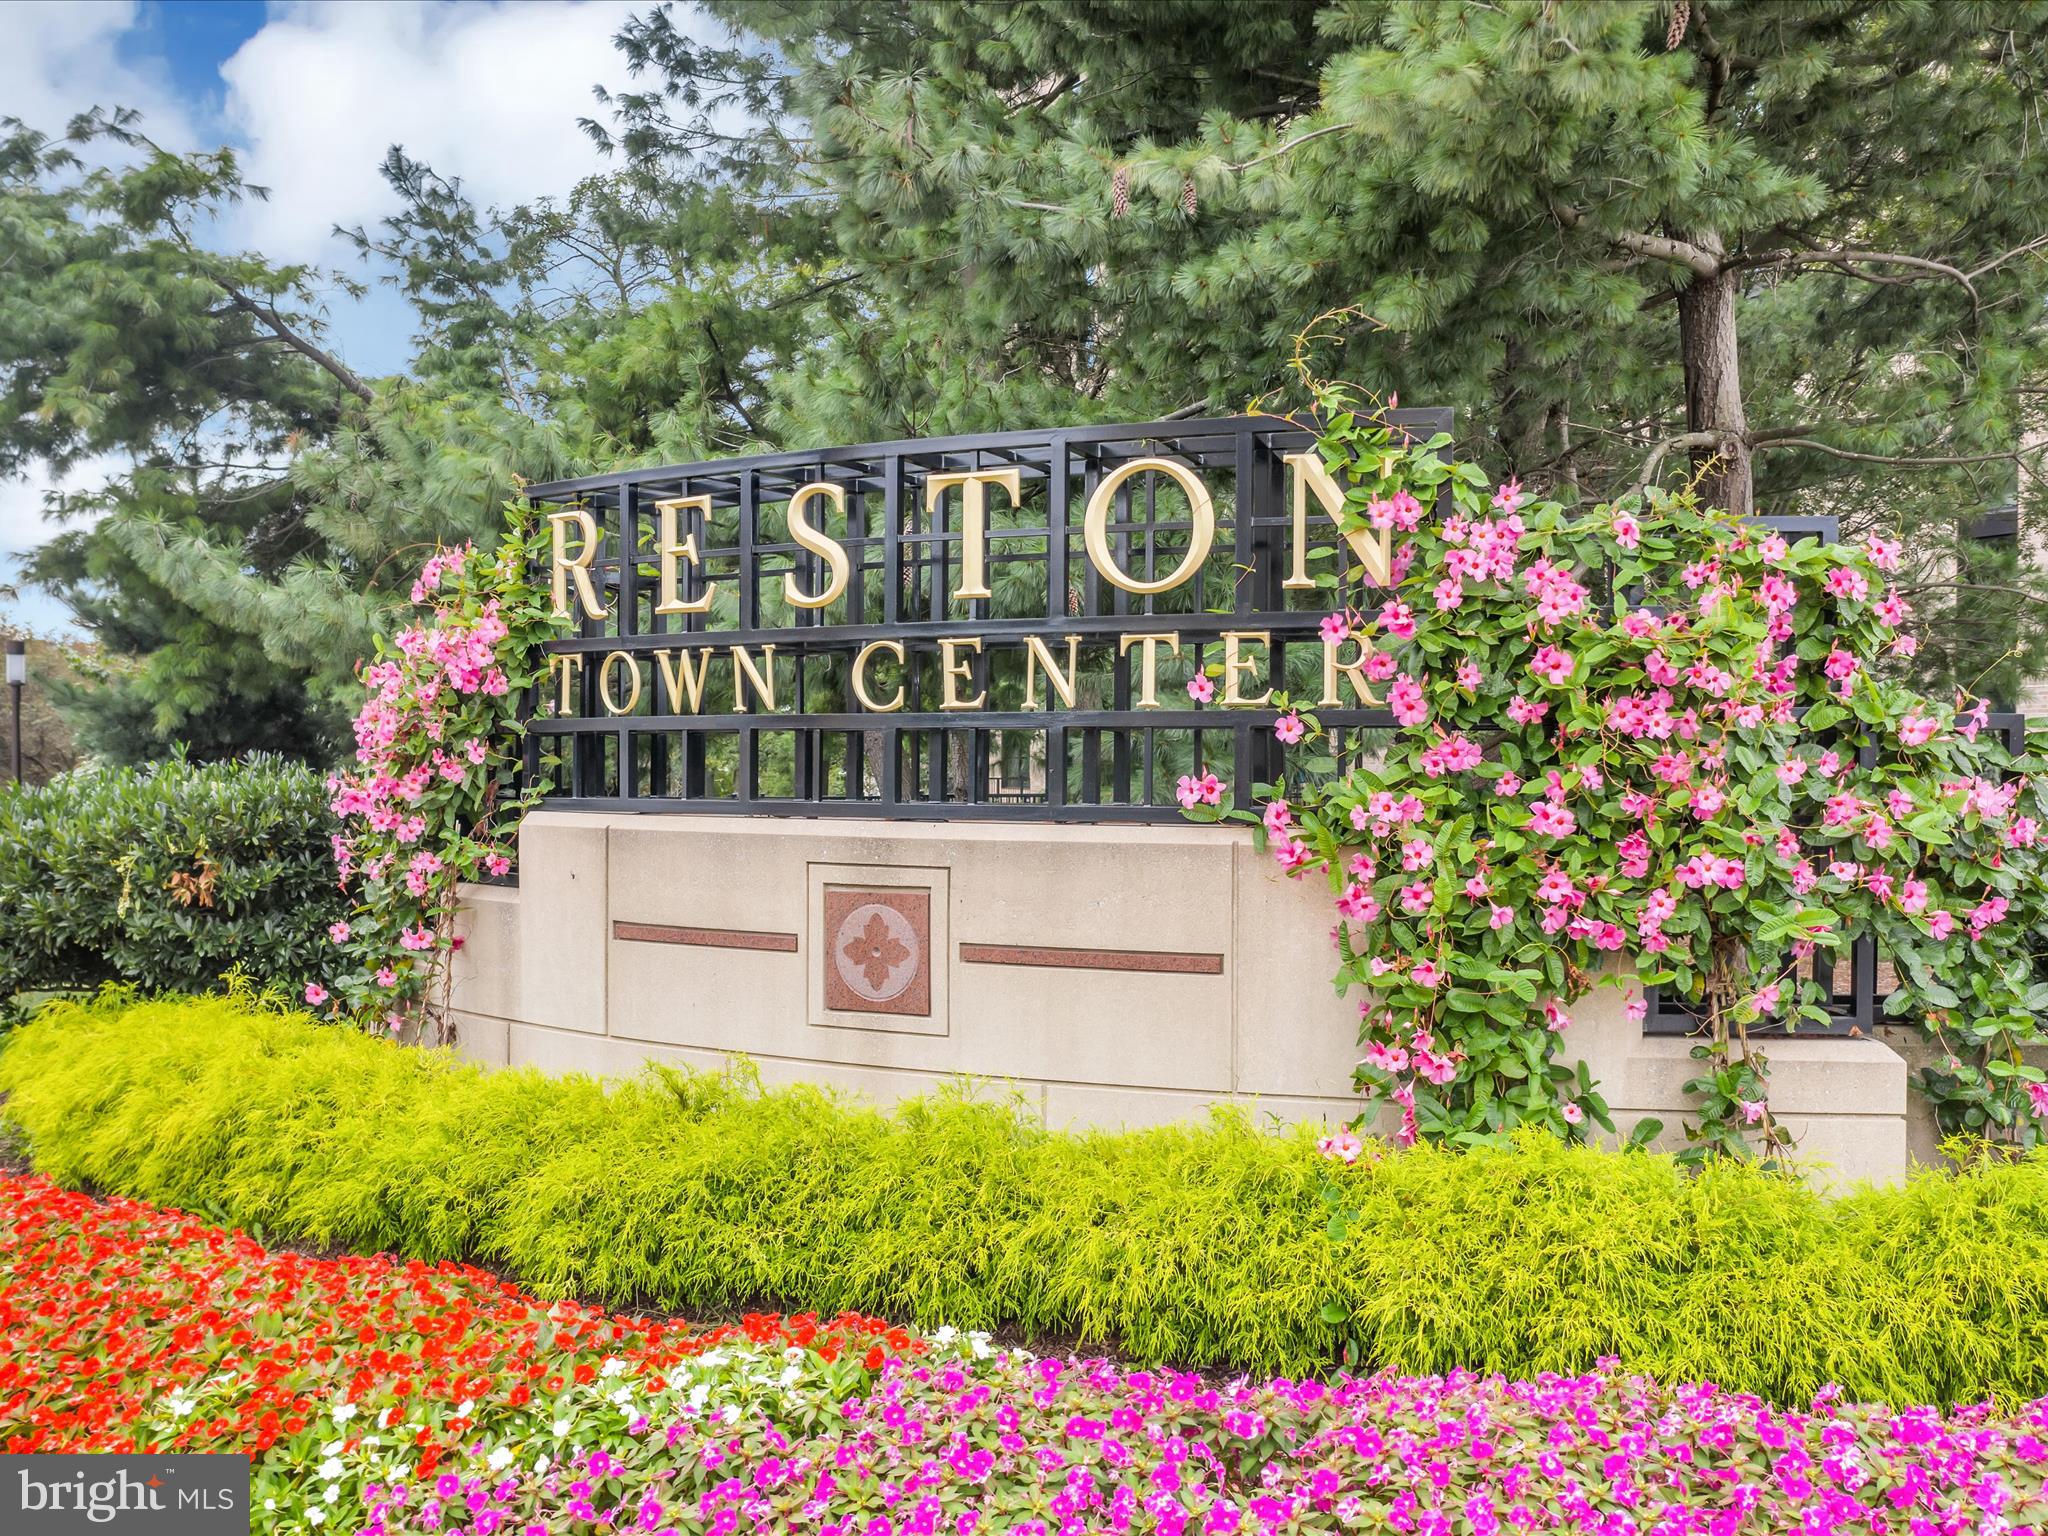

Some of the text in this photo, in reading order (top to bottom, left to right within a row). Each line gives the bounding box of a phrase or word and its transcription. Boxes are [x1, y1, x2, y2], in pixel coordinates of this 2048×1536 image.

[547, 454, 1403, 620] RESTON
[549, 631, 1385, 716] TOWN CENTER
